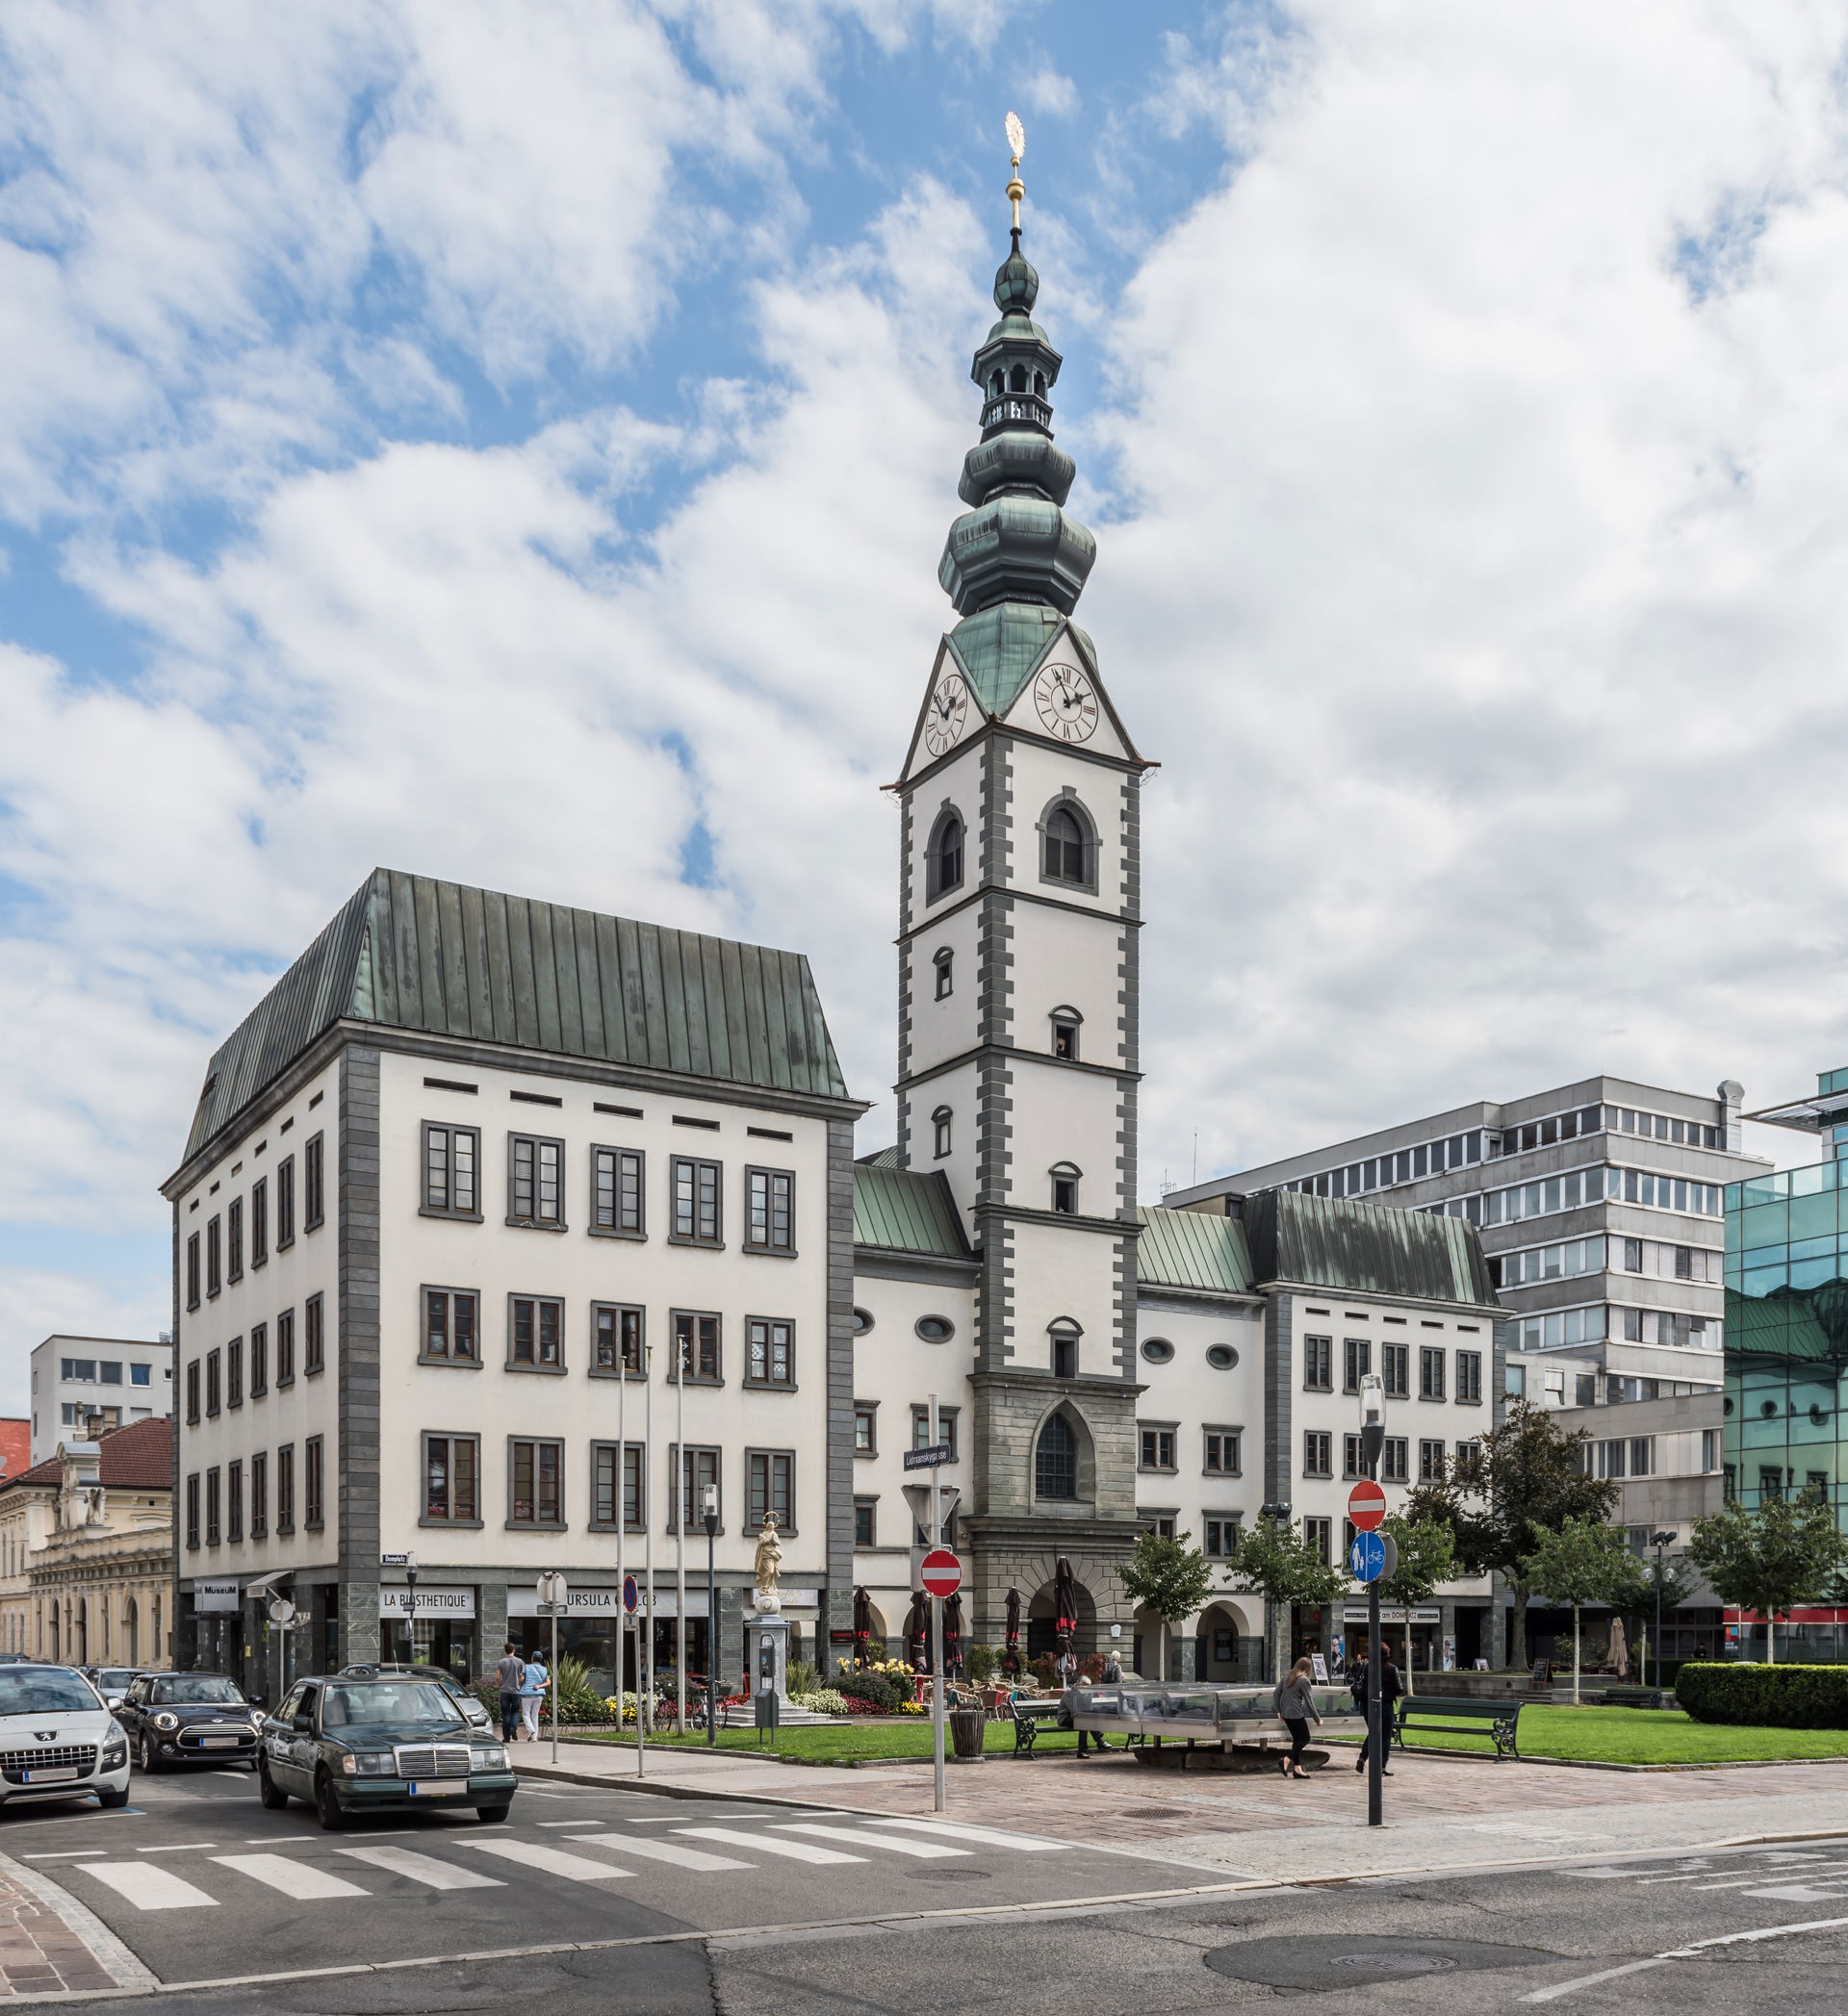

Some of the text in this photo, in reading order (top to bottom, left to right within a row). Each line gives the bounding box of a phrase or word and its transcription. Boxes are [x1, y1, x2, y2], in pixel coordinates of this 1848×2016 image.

[385, 1554, 405, 1564] Domplatz
[385, 1594, 396, 1606] LA
[567, 1594, 610, 1606] URSULA
